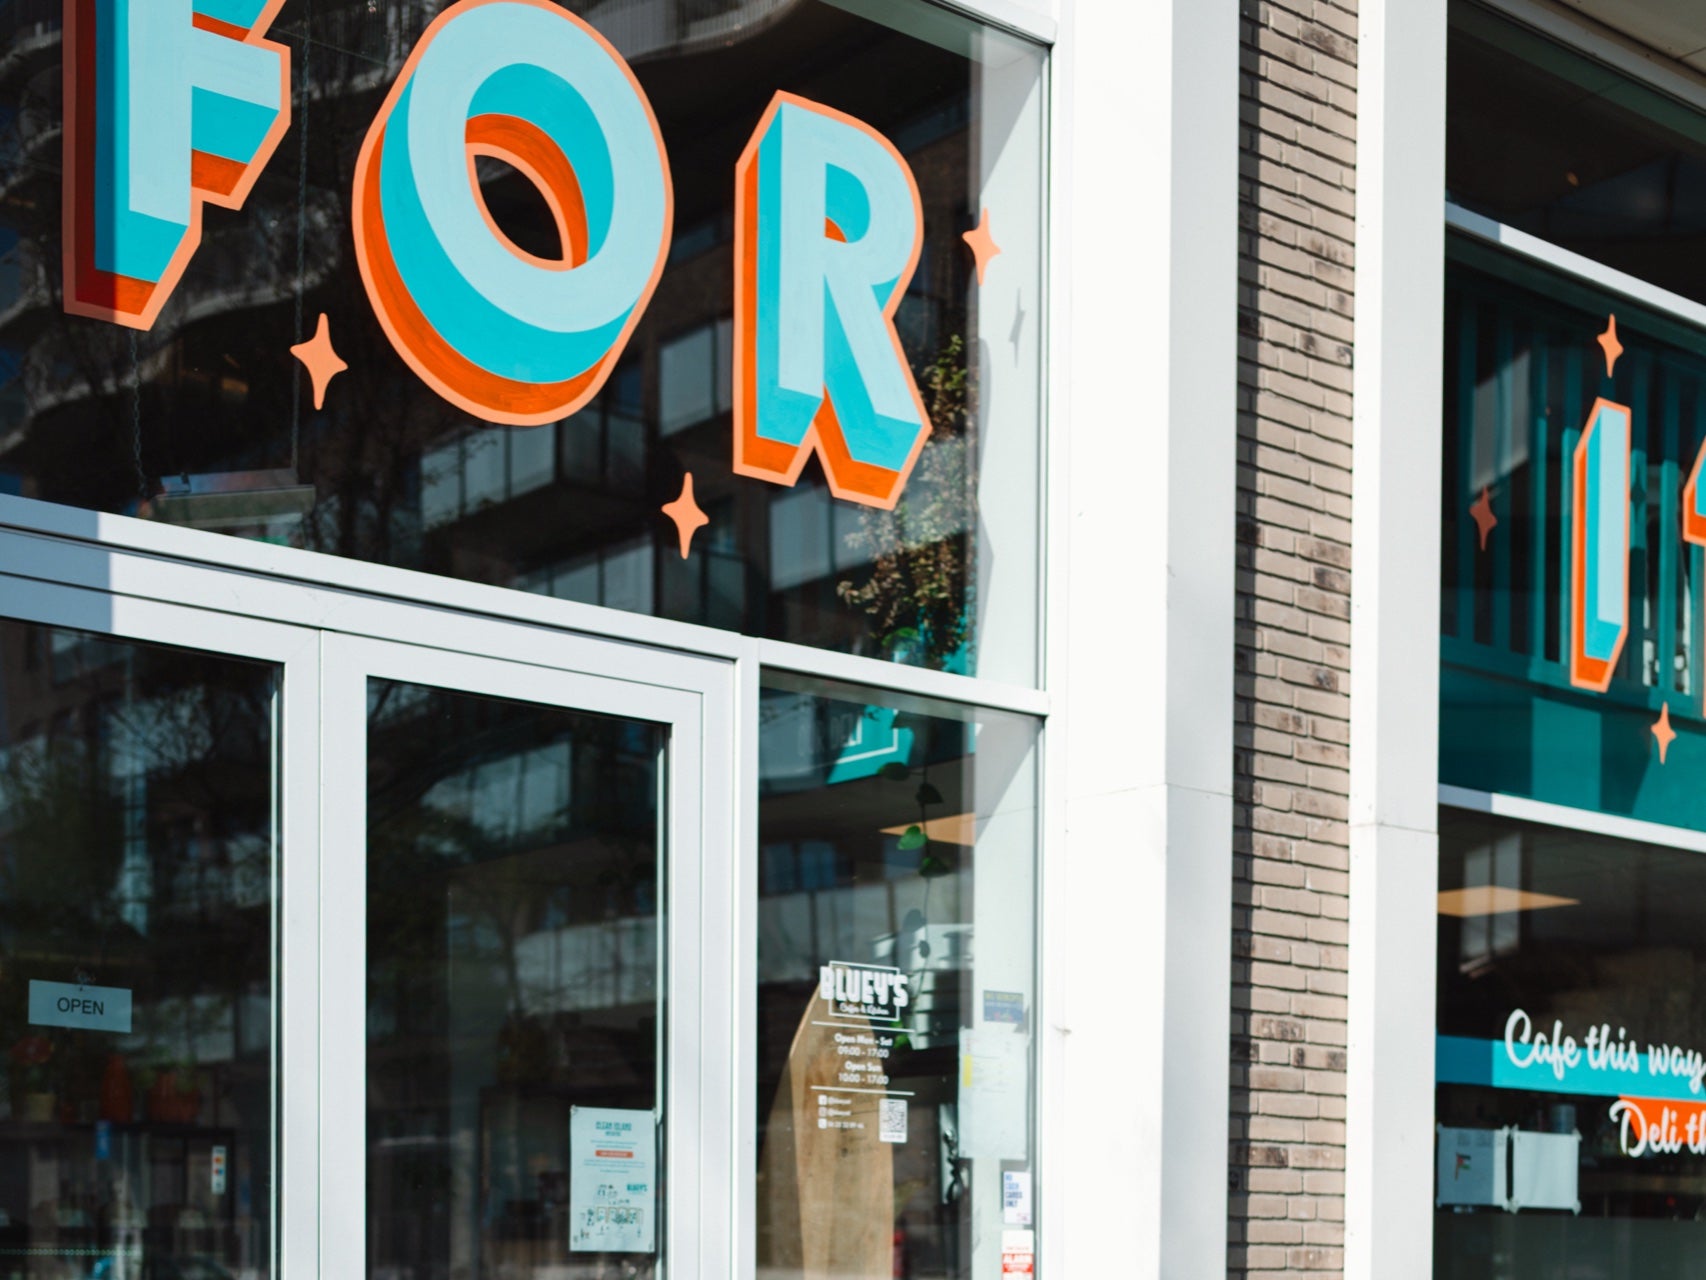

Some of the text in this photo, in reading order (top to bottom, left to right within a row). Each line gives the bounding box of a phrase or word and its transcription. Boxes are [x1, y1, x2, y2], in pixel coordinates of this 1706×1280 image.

[63, 0, 933, 511] FOR
[57, 997, 104, 1015] OPEN
[819, 965, 909, 1007] BLUEY'S
[1505, 1008, 1706, 1094] Cafe this way
[1609, 1100, 1683, 1158] Deli
